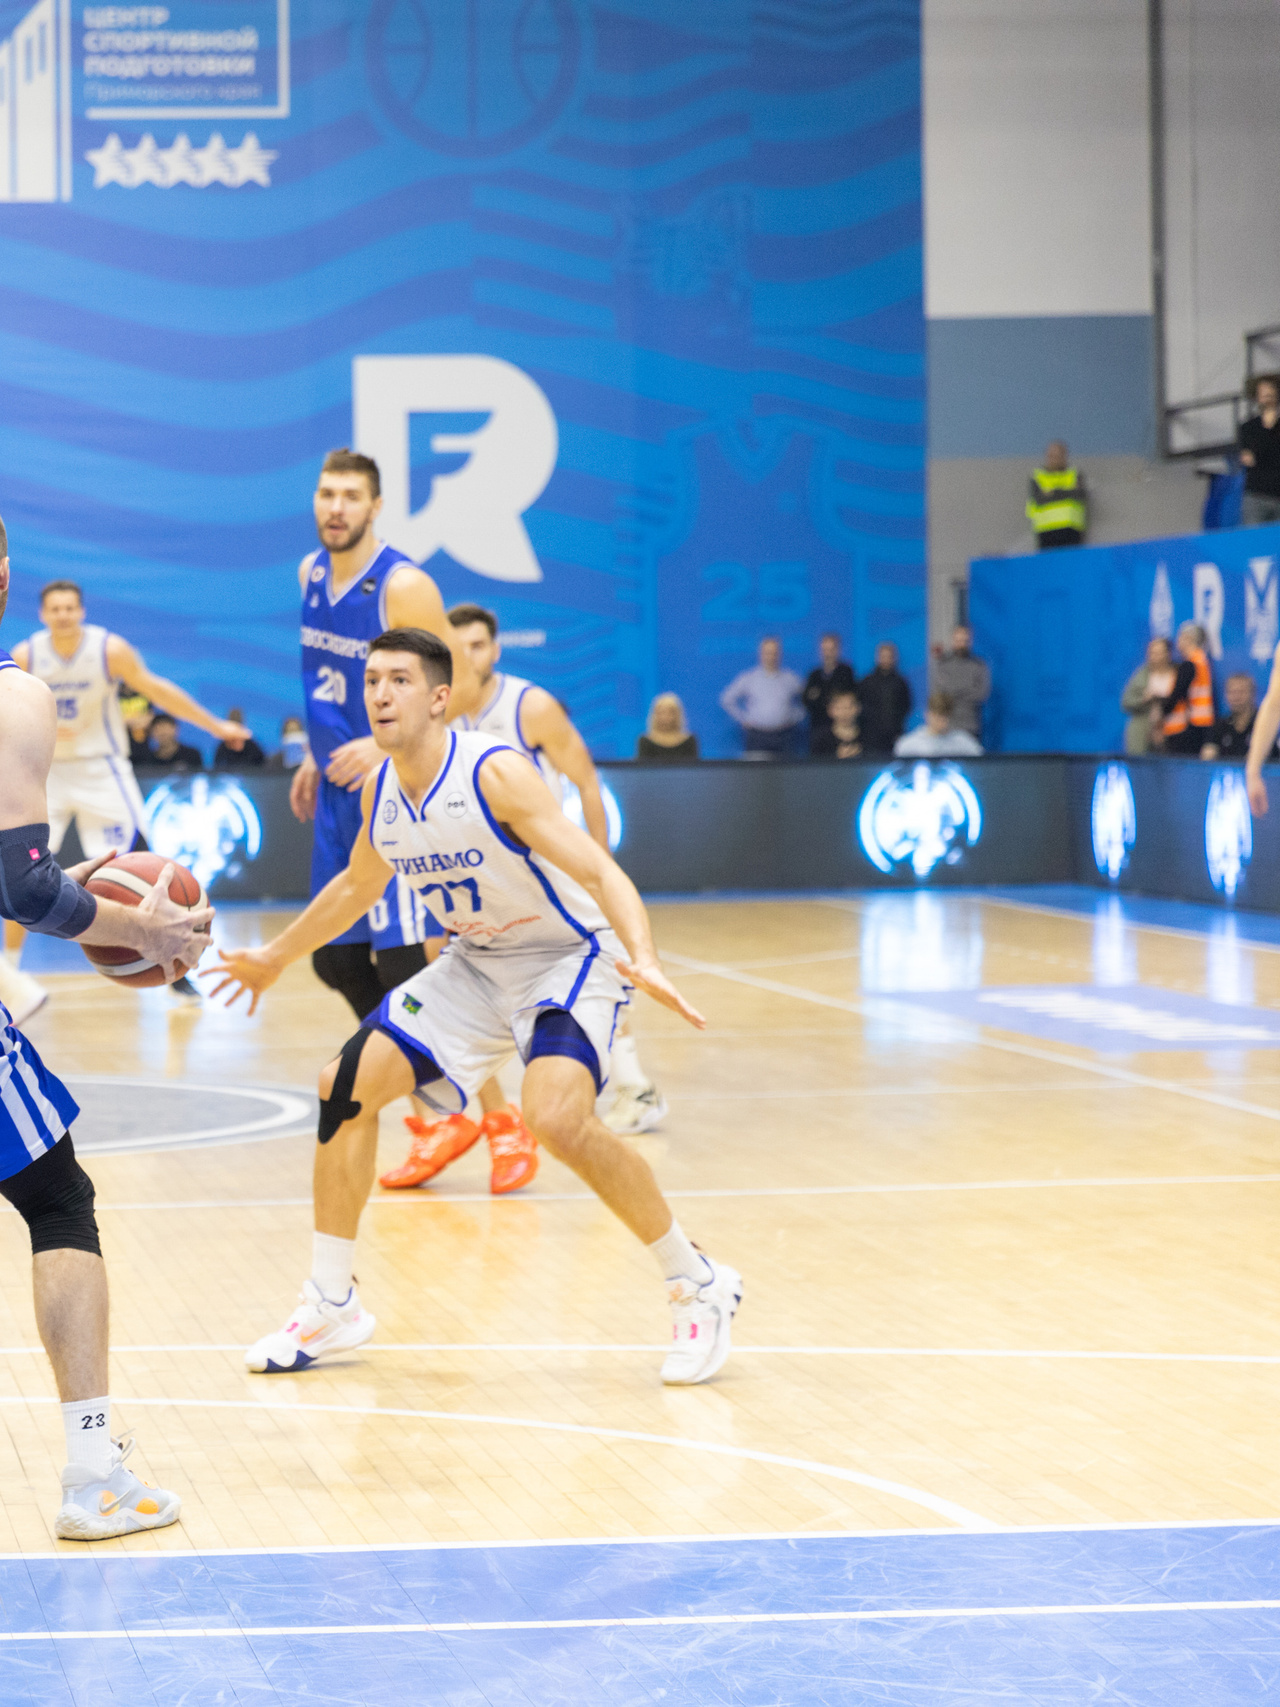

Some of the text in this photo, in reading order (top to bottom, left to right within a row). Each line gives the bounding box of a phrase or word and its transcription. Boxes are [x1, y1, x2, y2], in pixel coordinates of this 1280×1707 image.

[313, 666, 347, 705] 20
[418, 877, 482, 914] 77
[81, 1413, 105, 1429] 23
